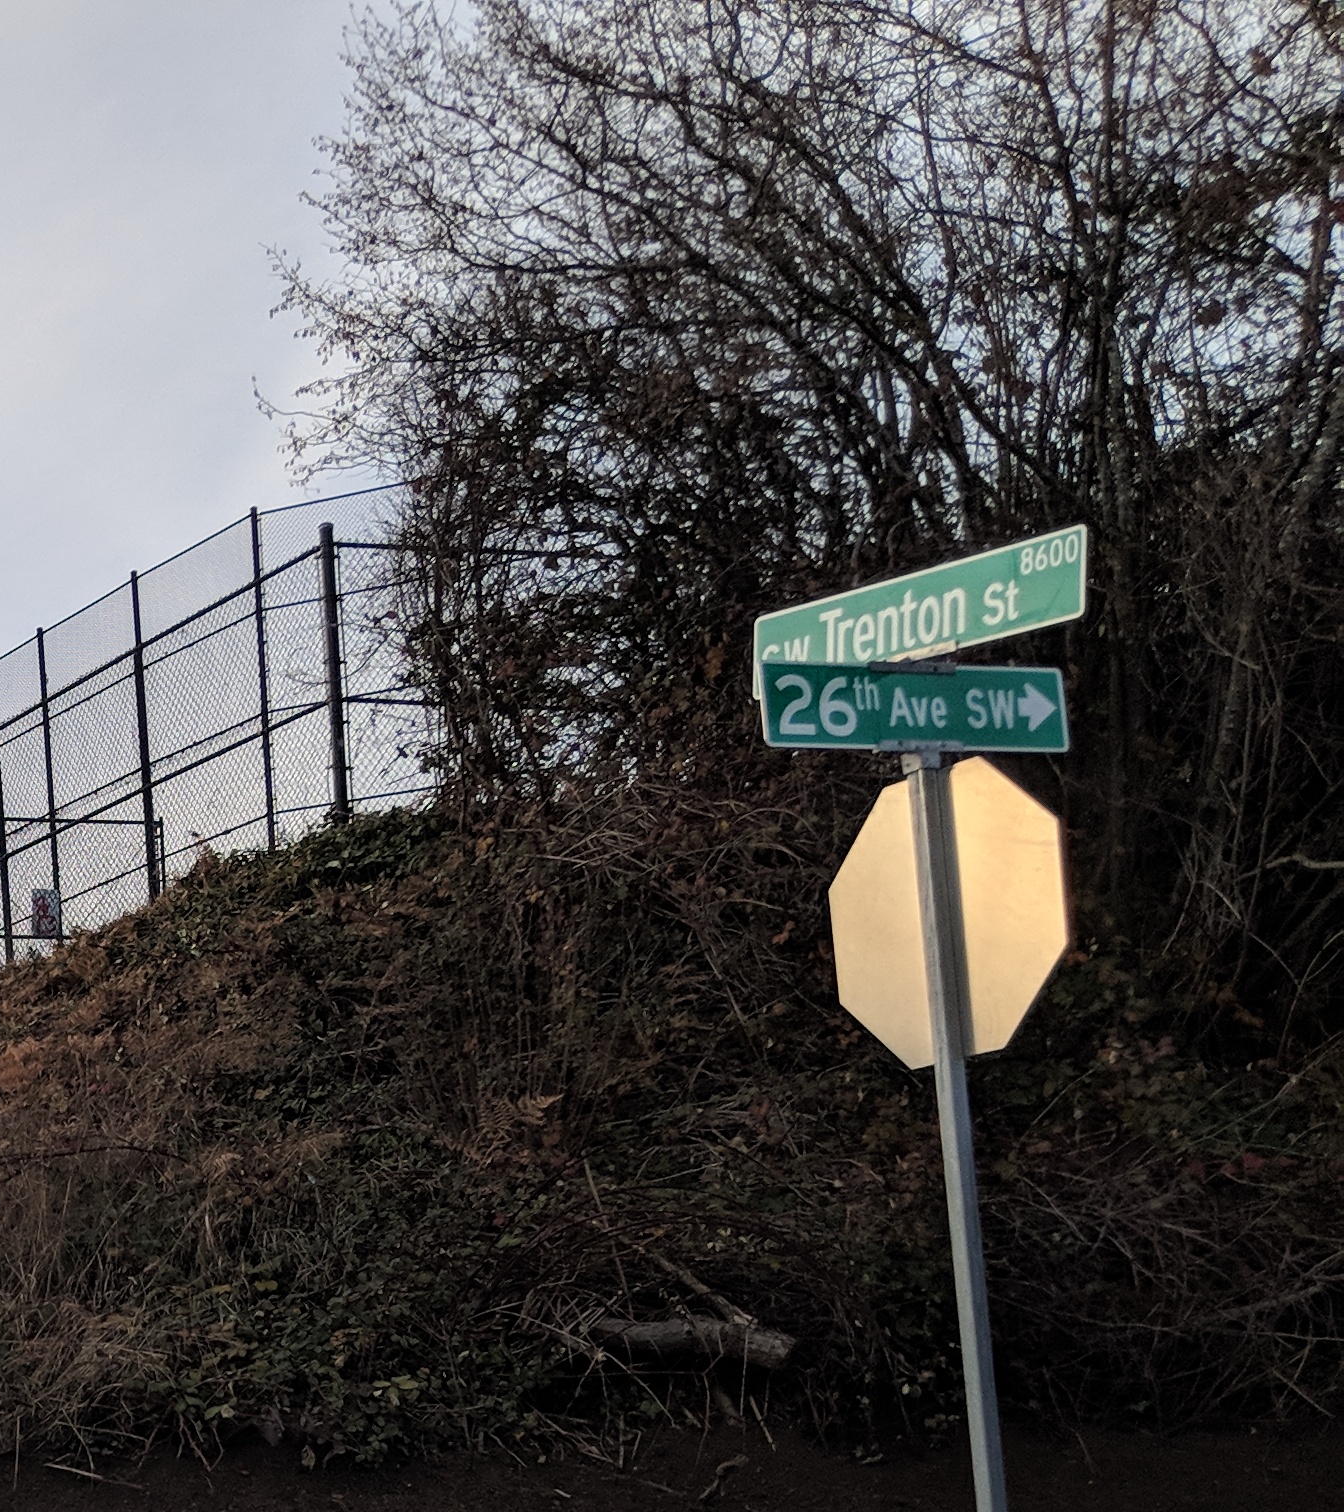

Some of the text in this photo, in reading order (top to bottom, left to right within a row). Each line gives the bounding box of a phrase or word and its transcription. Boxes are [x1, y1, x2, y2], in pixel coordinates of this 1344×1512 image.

[1020, 535, 1079, 576] 8600
[819, 587, 965, 663] Trenton
[982, 580, 1019, 627] St
[774, 673, 1014, 737] 26th Ave SW
